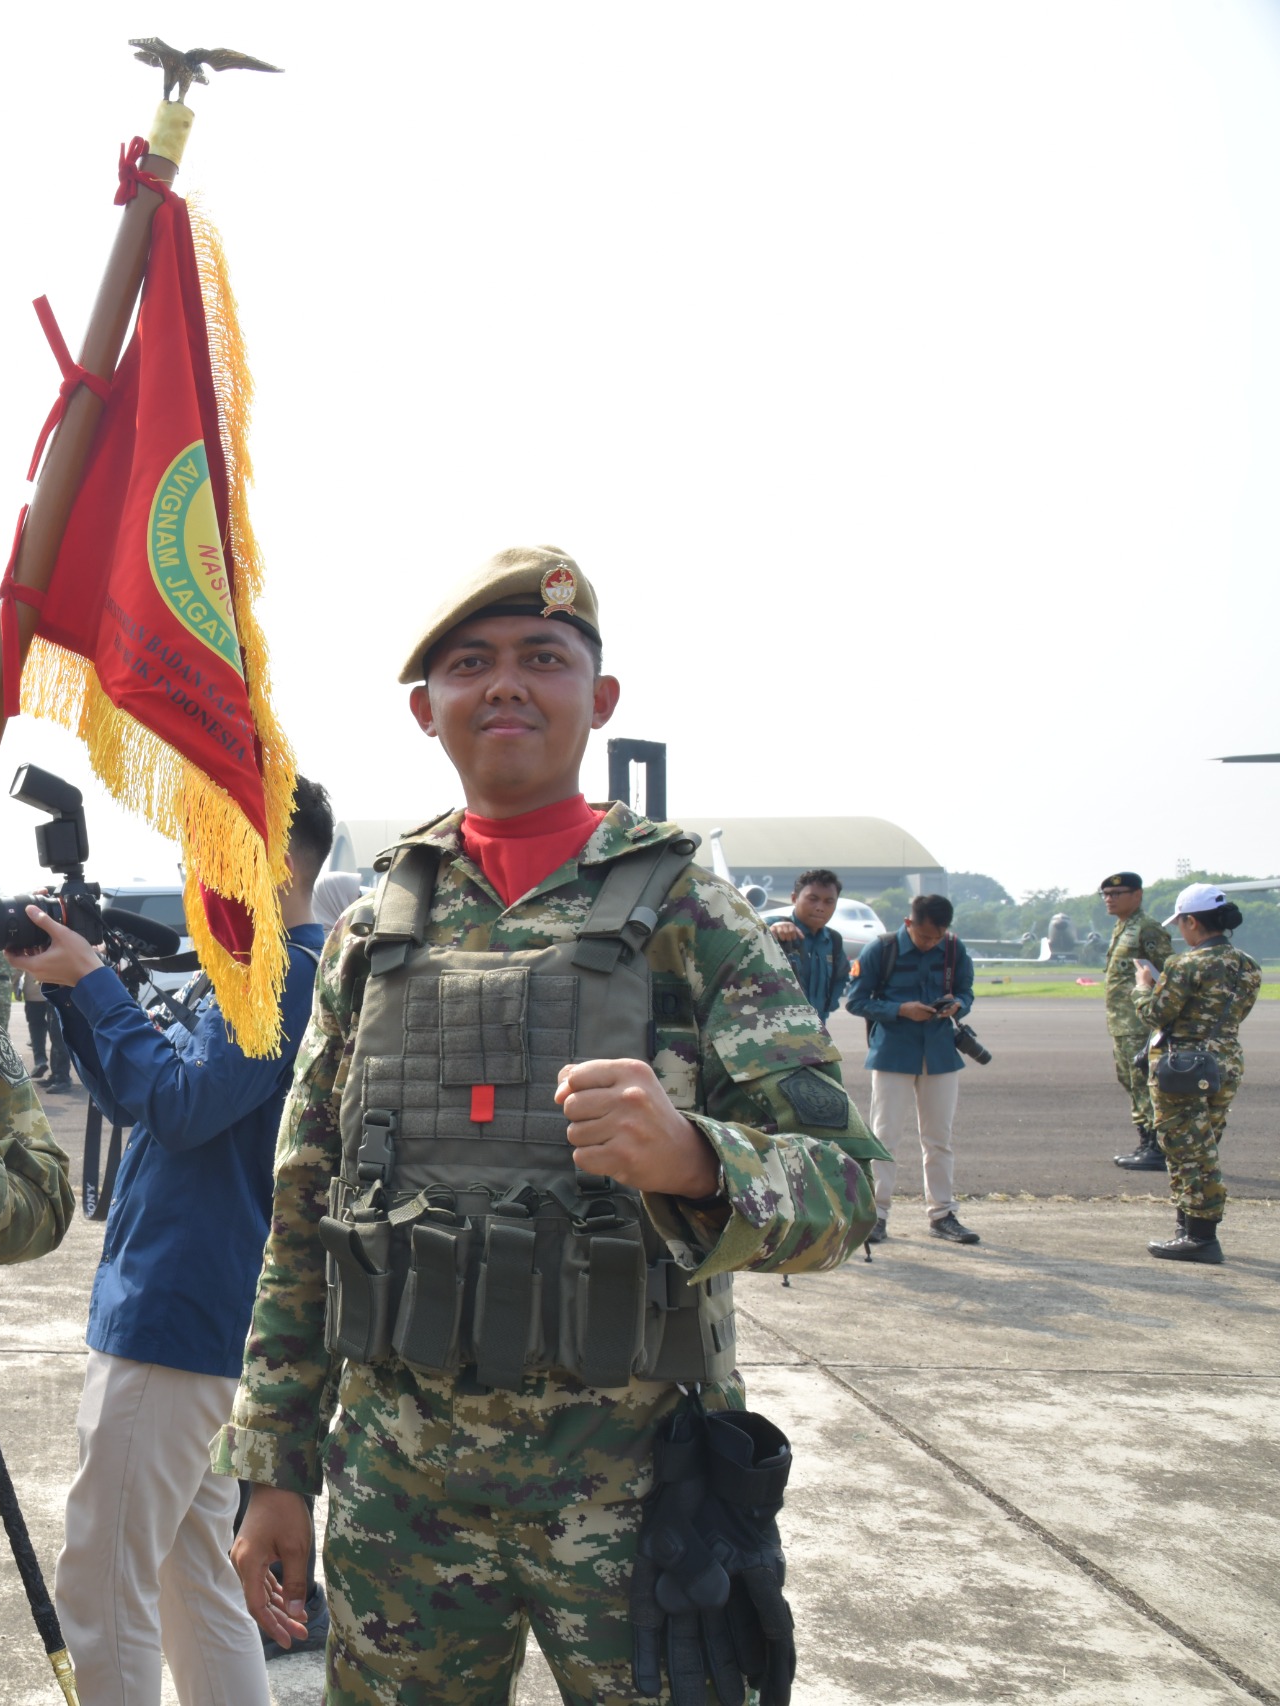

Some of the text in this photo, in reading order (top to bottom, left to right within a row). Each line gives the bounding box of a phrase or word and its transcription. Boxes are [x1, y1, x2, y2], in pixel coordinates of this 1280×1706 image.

[156, 457, 231, 647] AVIGNAM JAGAT
[145, 634, 206, 689] BADAN
[202, 681, 236, 719] SAR
[152, 675, 247, 761] INDONESIA
